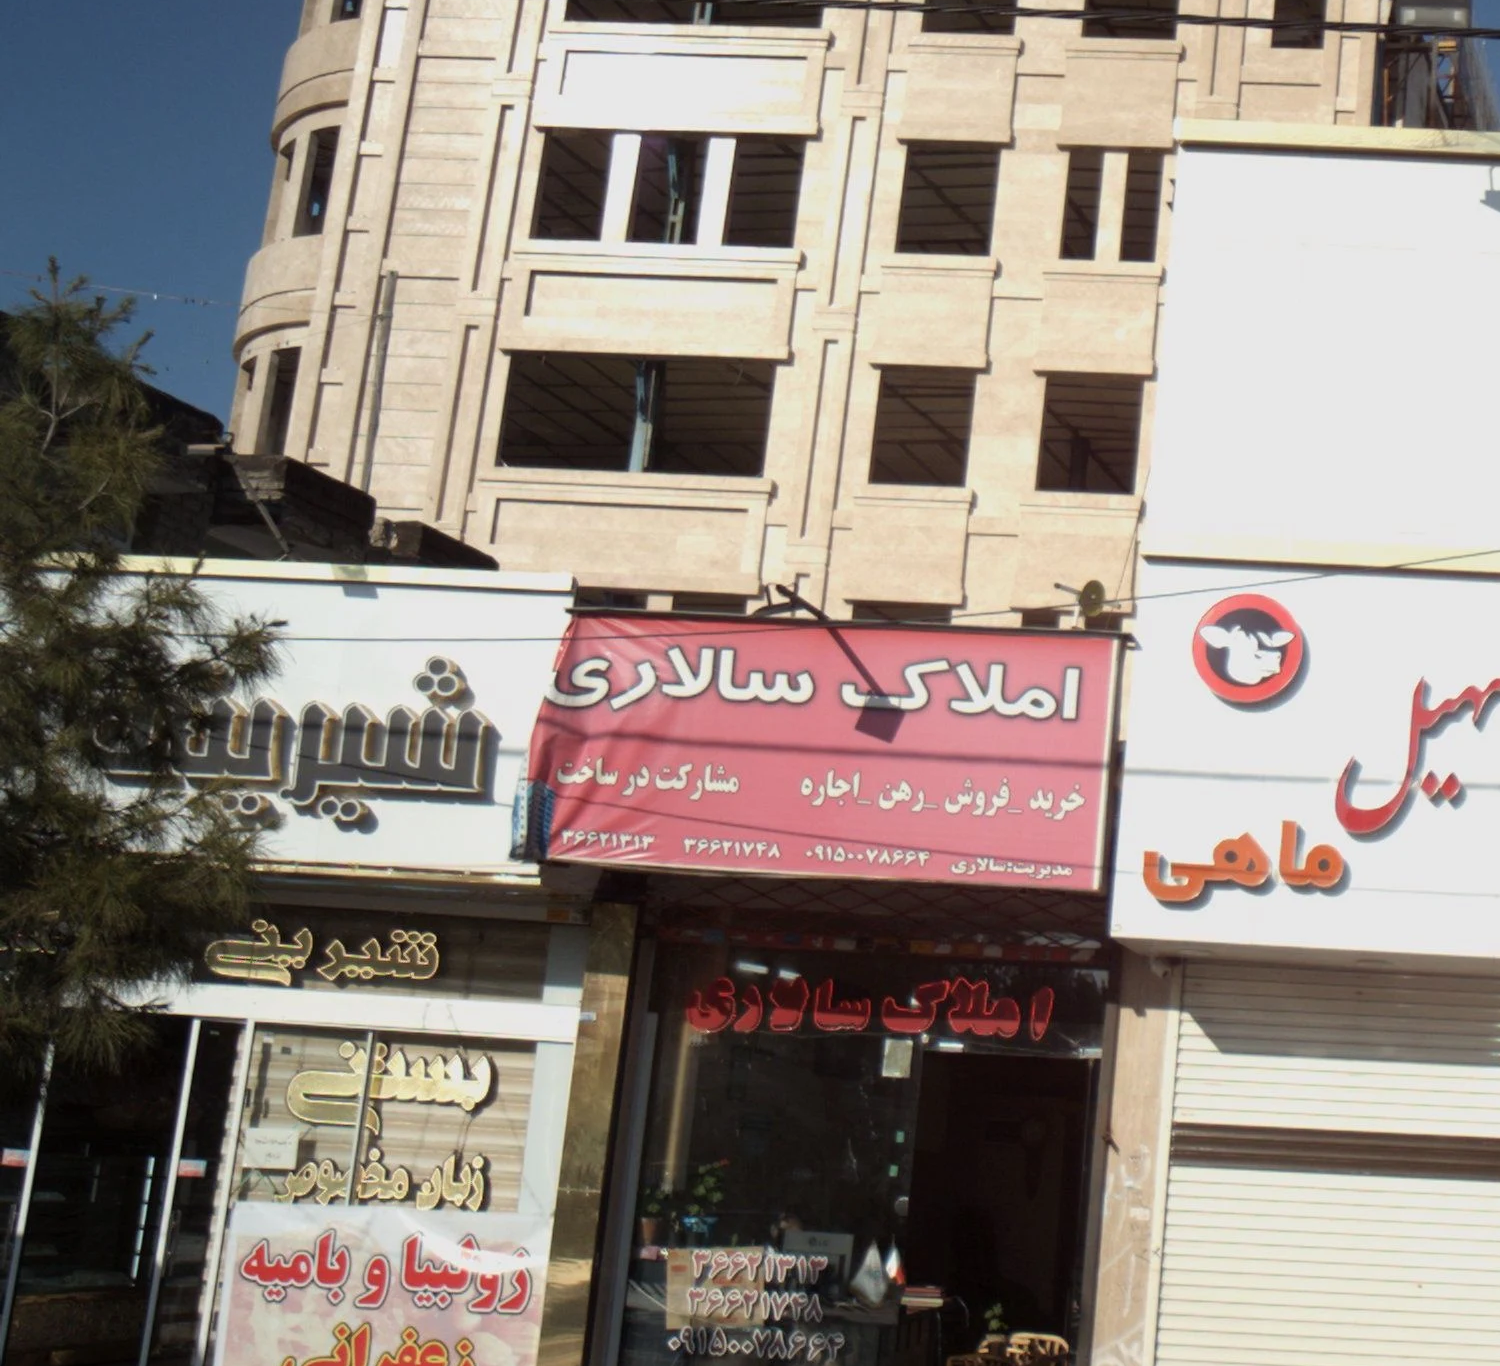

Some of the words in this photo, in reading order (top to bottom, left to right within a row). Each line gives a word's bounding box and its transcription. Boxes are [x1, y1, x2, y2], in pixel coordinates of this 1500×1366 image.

[543, 645, 815, 711] سالاری
[841, 658, 1081, 721] املاک
[556, 756, 619, 786] ساخت
[622, 766, 650, 796] در
[655, 763, 740, 800] مشارکت
[1029, 784, 1085, 820] خرید
[1142, 818, 1344, 902] ماهی
[206, 919, 440, 986] شیرینی
[685, 977, 871, 1034] سالاری
[882, 977, 1054, 1041] املاک
[286, 1040, 493, 1135] بستنی
[416, 1153, 485, 1212] زبان
[240, 1227, 351, 1305] بامیه
[354, 1254, 392, 1310] و
[692, 1249, 829, 1285] ۳۶۶۲۱۳۱۳
[686, 1286, 824, 1324] ۳۶۶۲۱۷۴۸
[667, 1325, 846, 1362] ۰۹۱۵۰۰۷۸۶۶۴
